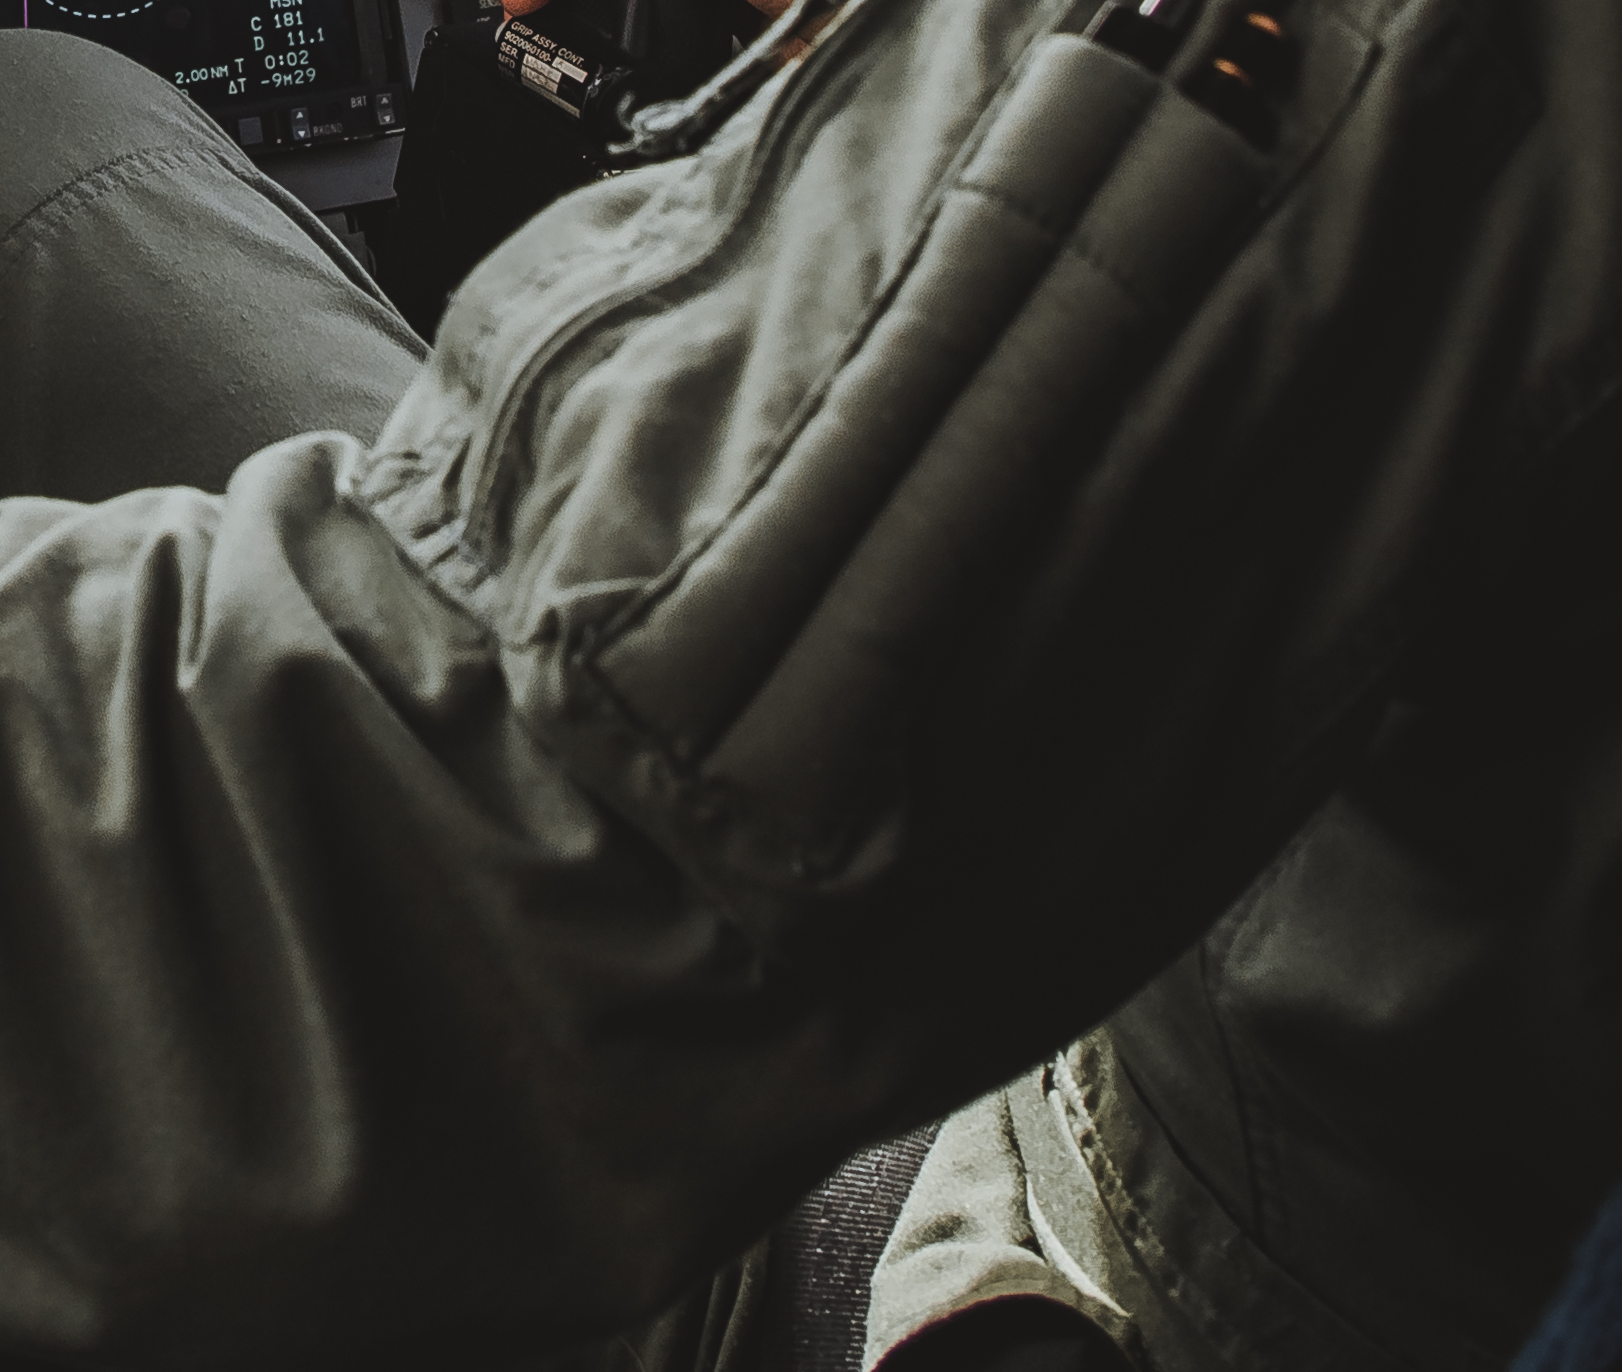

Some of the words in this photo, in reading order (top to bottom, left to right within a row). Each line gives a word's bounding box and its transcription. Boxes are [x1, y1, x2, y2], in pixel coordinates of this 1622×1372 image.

[273, 11, 303, 29] 181
[286, 29, 325, 47] 11.1
[510, 21, 533, 37] GRIP
[557, 47, 584, 67] CONT.
[265, 51, 311, 69] 0:02
